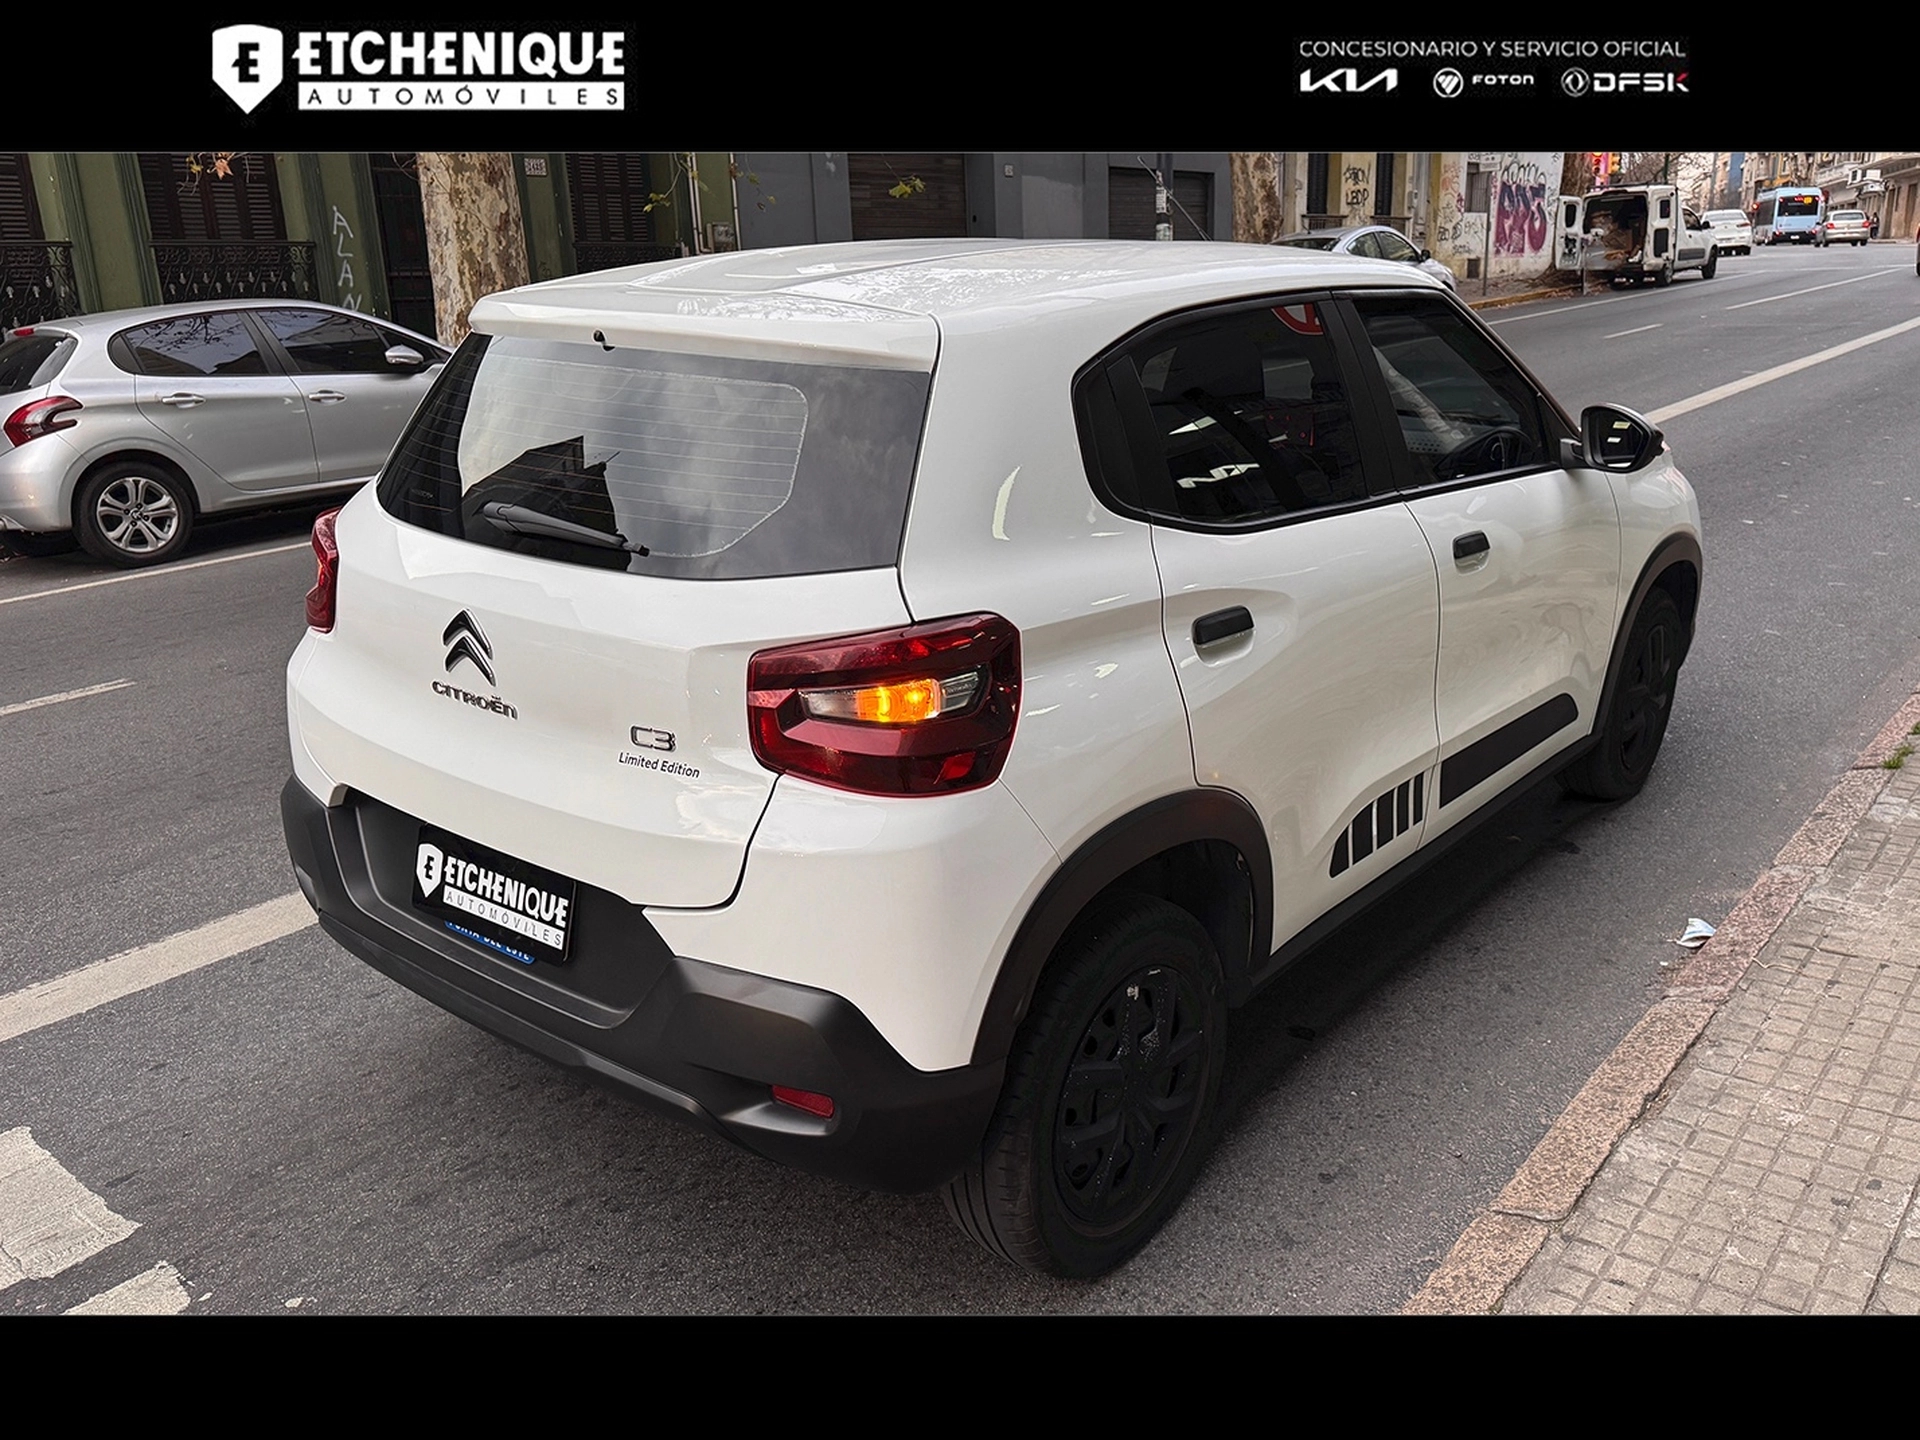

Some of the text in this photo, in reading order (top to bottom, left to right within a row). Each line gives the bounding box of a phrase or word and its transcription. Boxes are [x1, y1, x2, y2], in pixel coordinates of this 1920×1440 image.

[630, 725, 676, 752] C3
[618, 752, 700, 778] Limited Edition
[444, 855, 569, 928] ETCHENIQUE
[445, 891, 562, 946] AUTOMÓVILES
